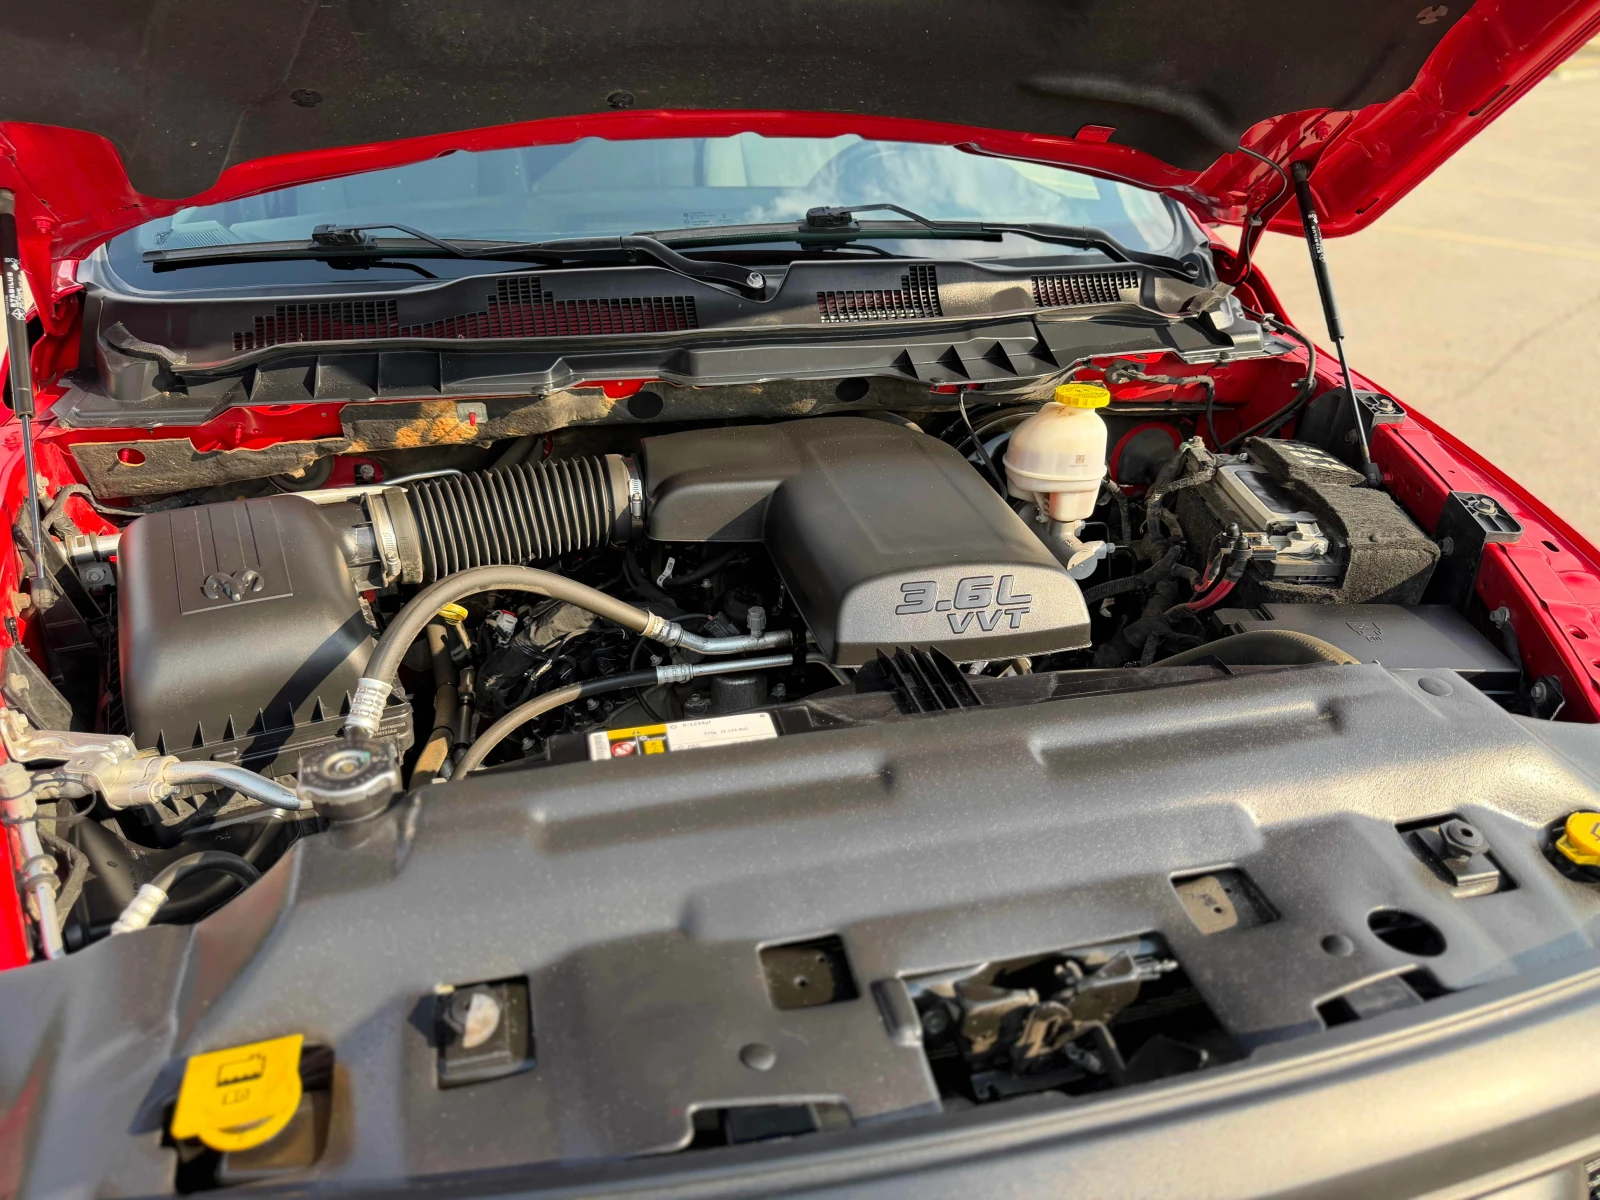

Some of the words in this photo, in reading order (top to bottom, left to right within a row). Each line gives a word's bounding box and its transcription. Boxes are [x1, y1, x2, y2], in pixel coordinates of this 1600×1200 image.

[1311, 225, 1321, 254] STABILUS
[6, 272, 16, 308] STABILUS
[895, 574, 1033, 615] 3.6L
[946, 607, 1031, 634] VVT
